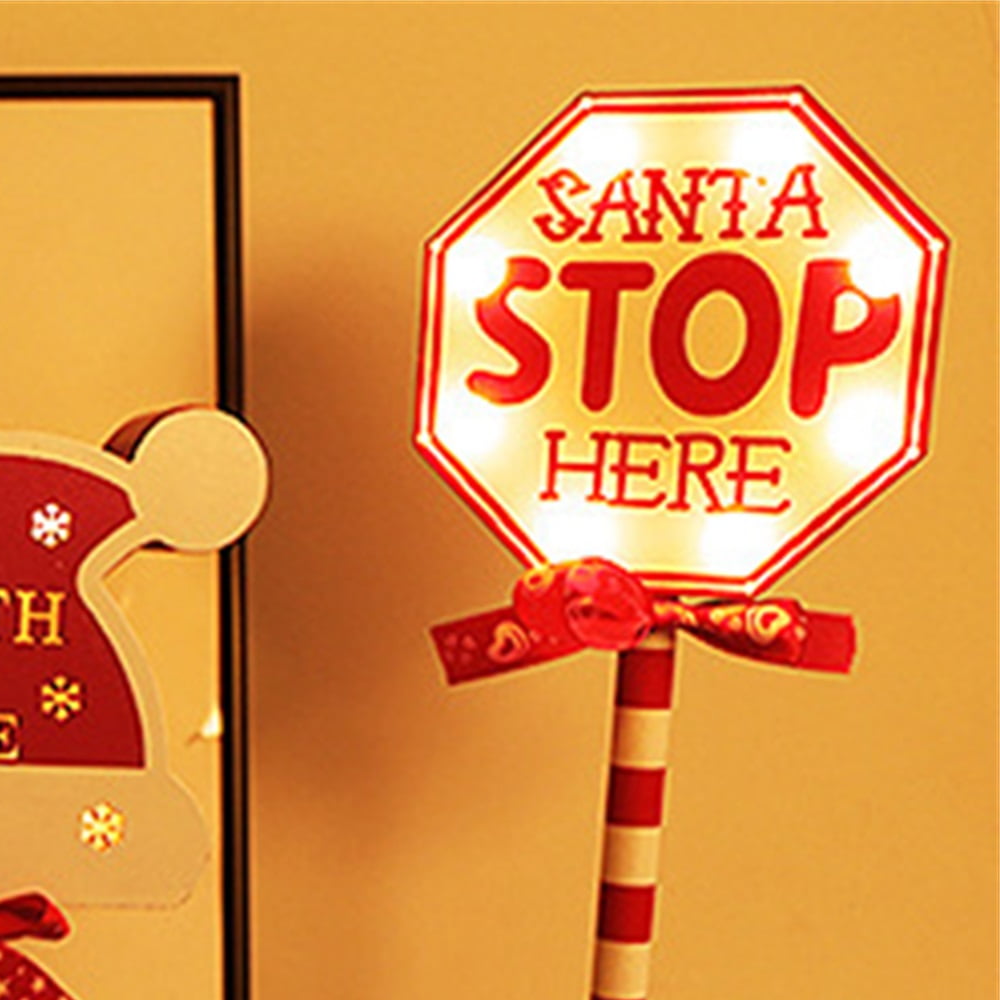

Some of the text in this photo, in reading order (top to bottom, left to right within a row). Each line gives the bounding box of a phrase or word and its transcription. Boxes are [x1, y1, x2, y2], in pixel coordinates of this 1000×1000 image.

[533, 164, 828, 243] SANTA
[466, 252, 902, 420] STOP
[540, 429, 792, 515] HERE
